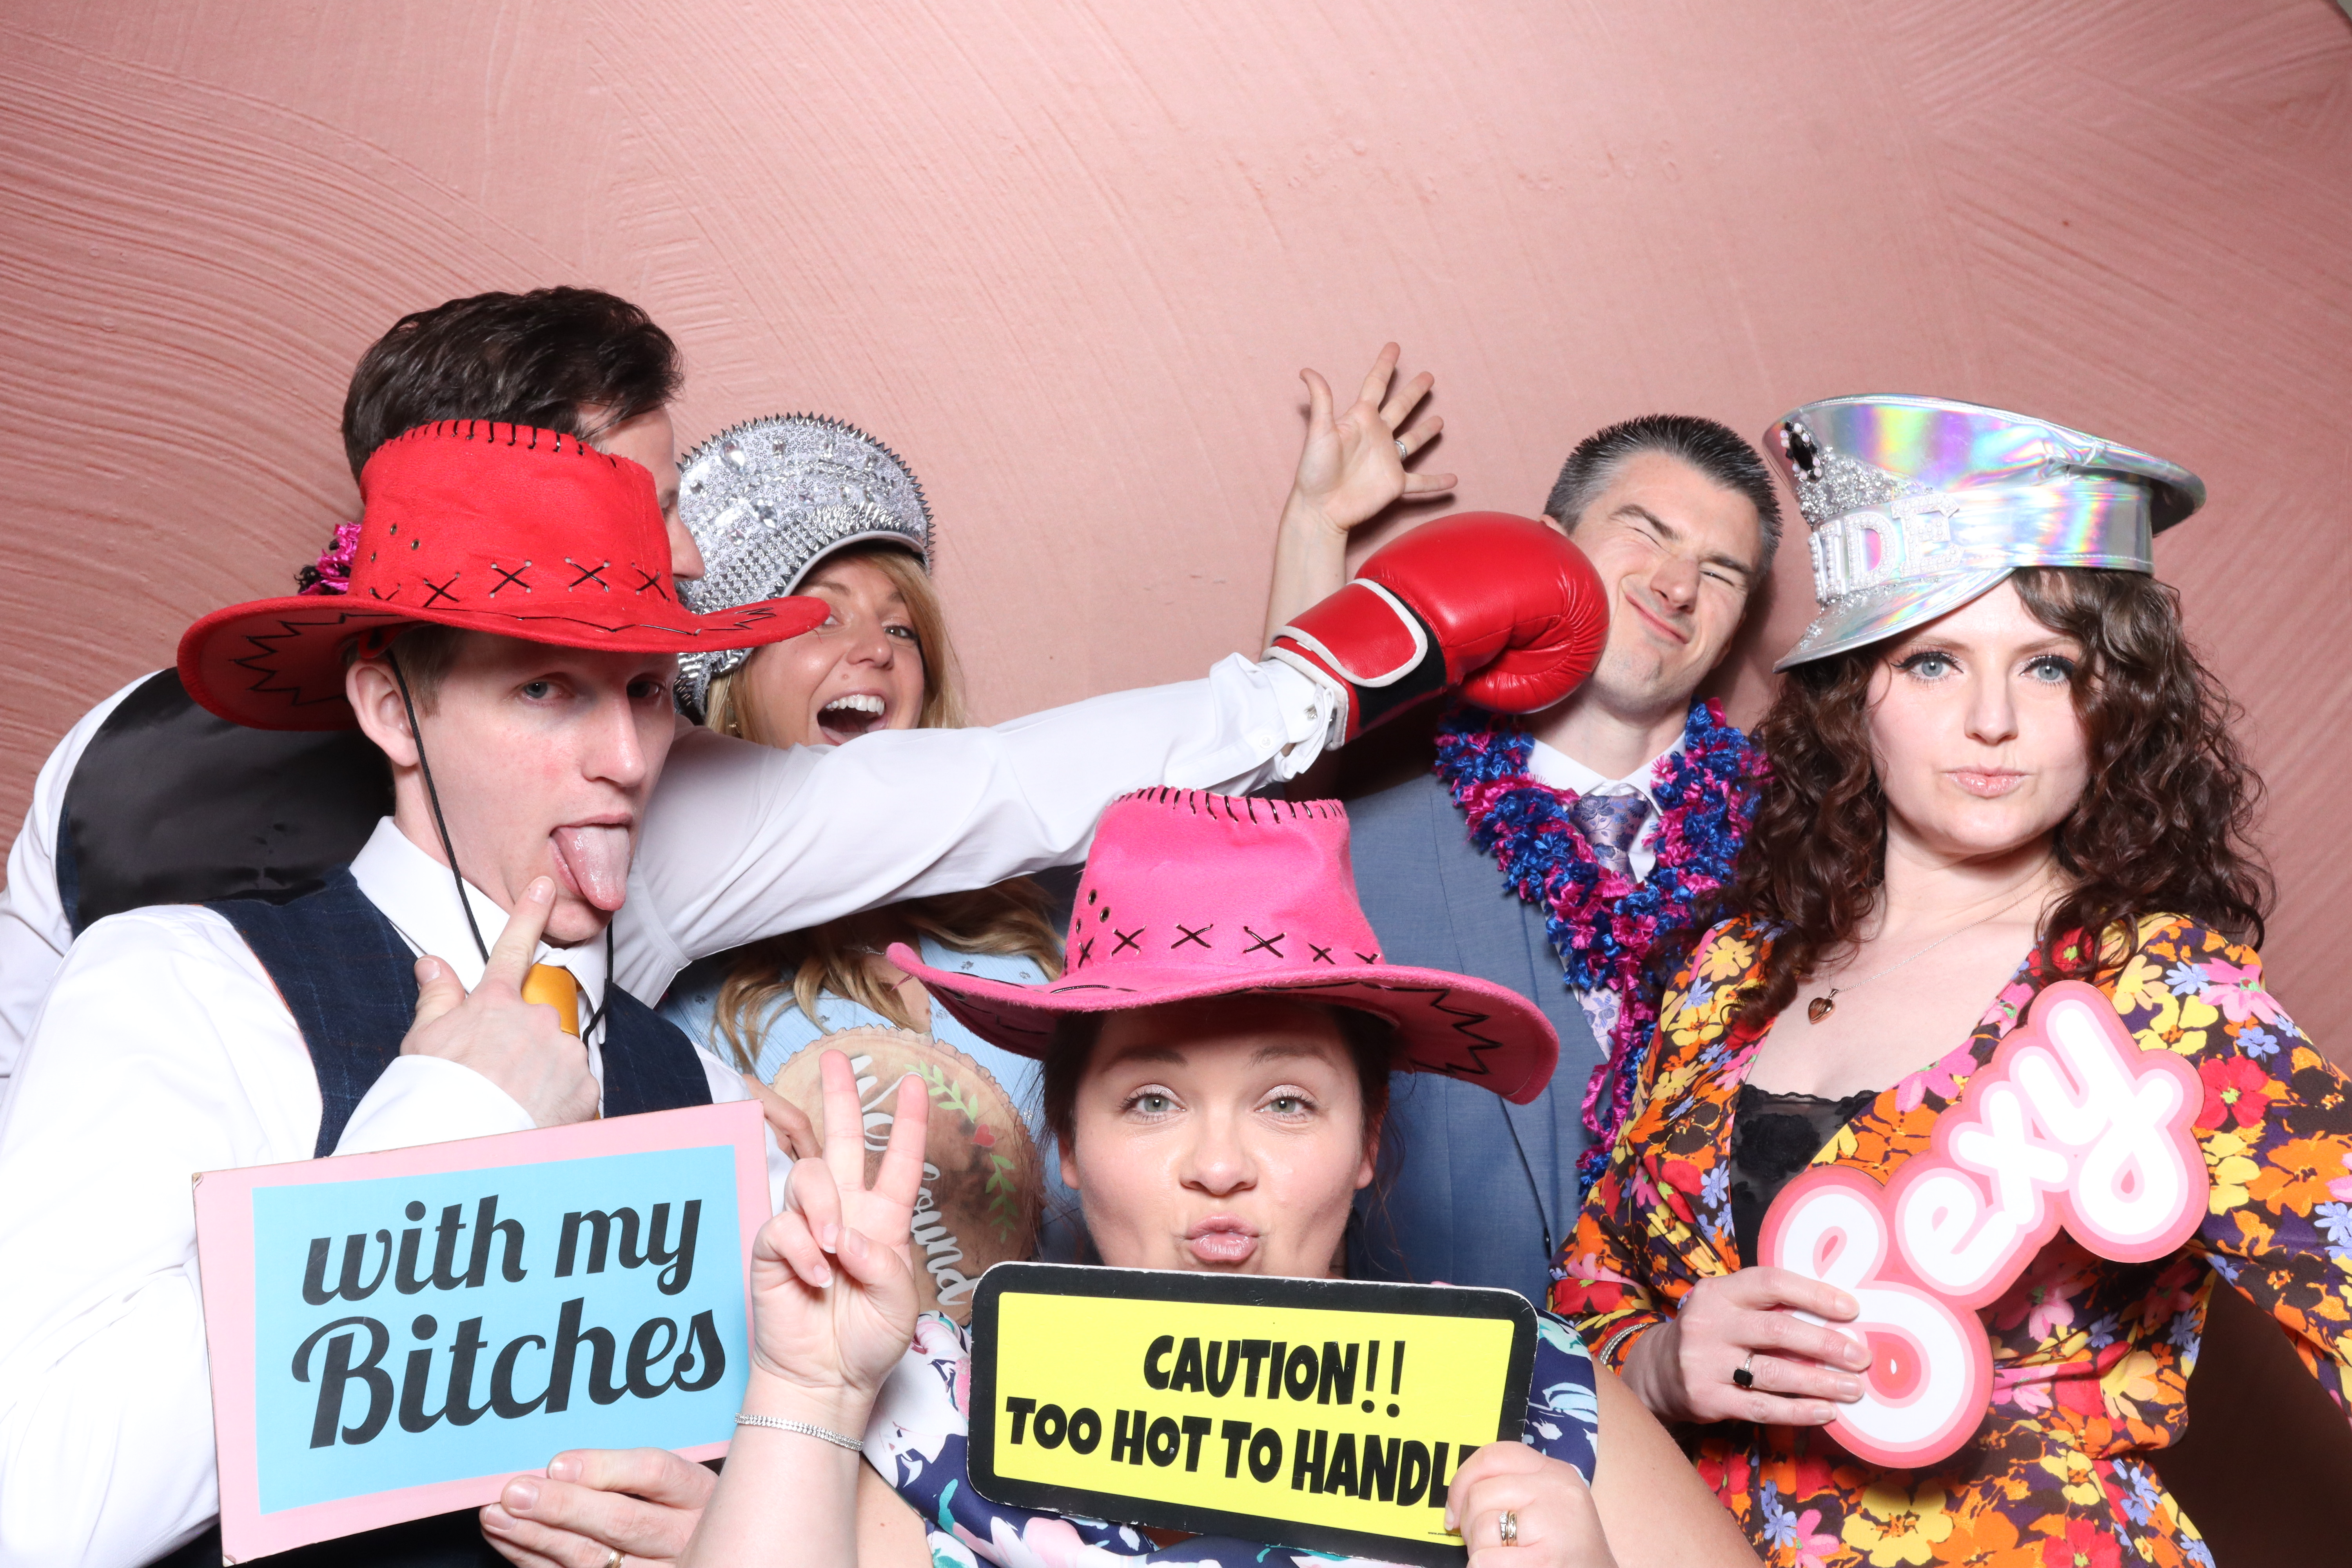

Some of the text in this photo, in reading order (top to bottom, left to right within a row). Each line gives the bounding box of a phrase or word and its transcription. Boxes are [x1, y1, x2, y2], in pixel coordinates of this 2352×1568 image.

[1808, 493, 1965, 603] IDE
[301, 1194, 702, 1306] with my
[1782, 999, 2179, 1443] Sexy
[291, 1297, 726, 1449] Bitches
[1143, 1335, 1405, 1417] CAUTION!!
[1005, 1396, 1482, 1508] TOO HOT TO HANDL
